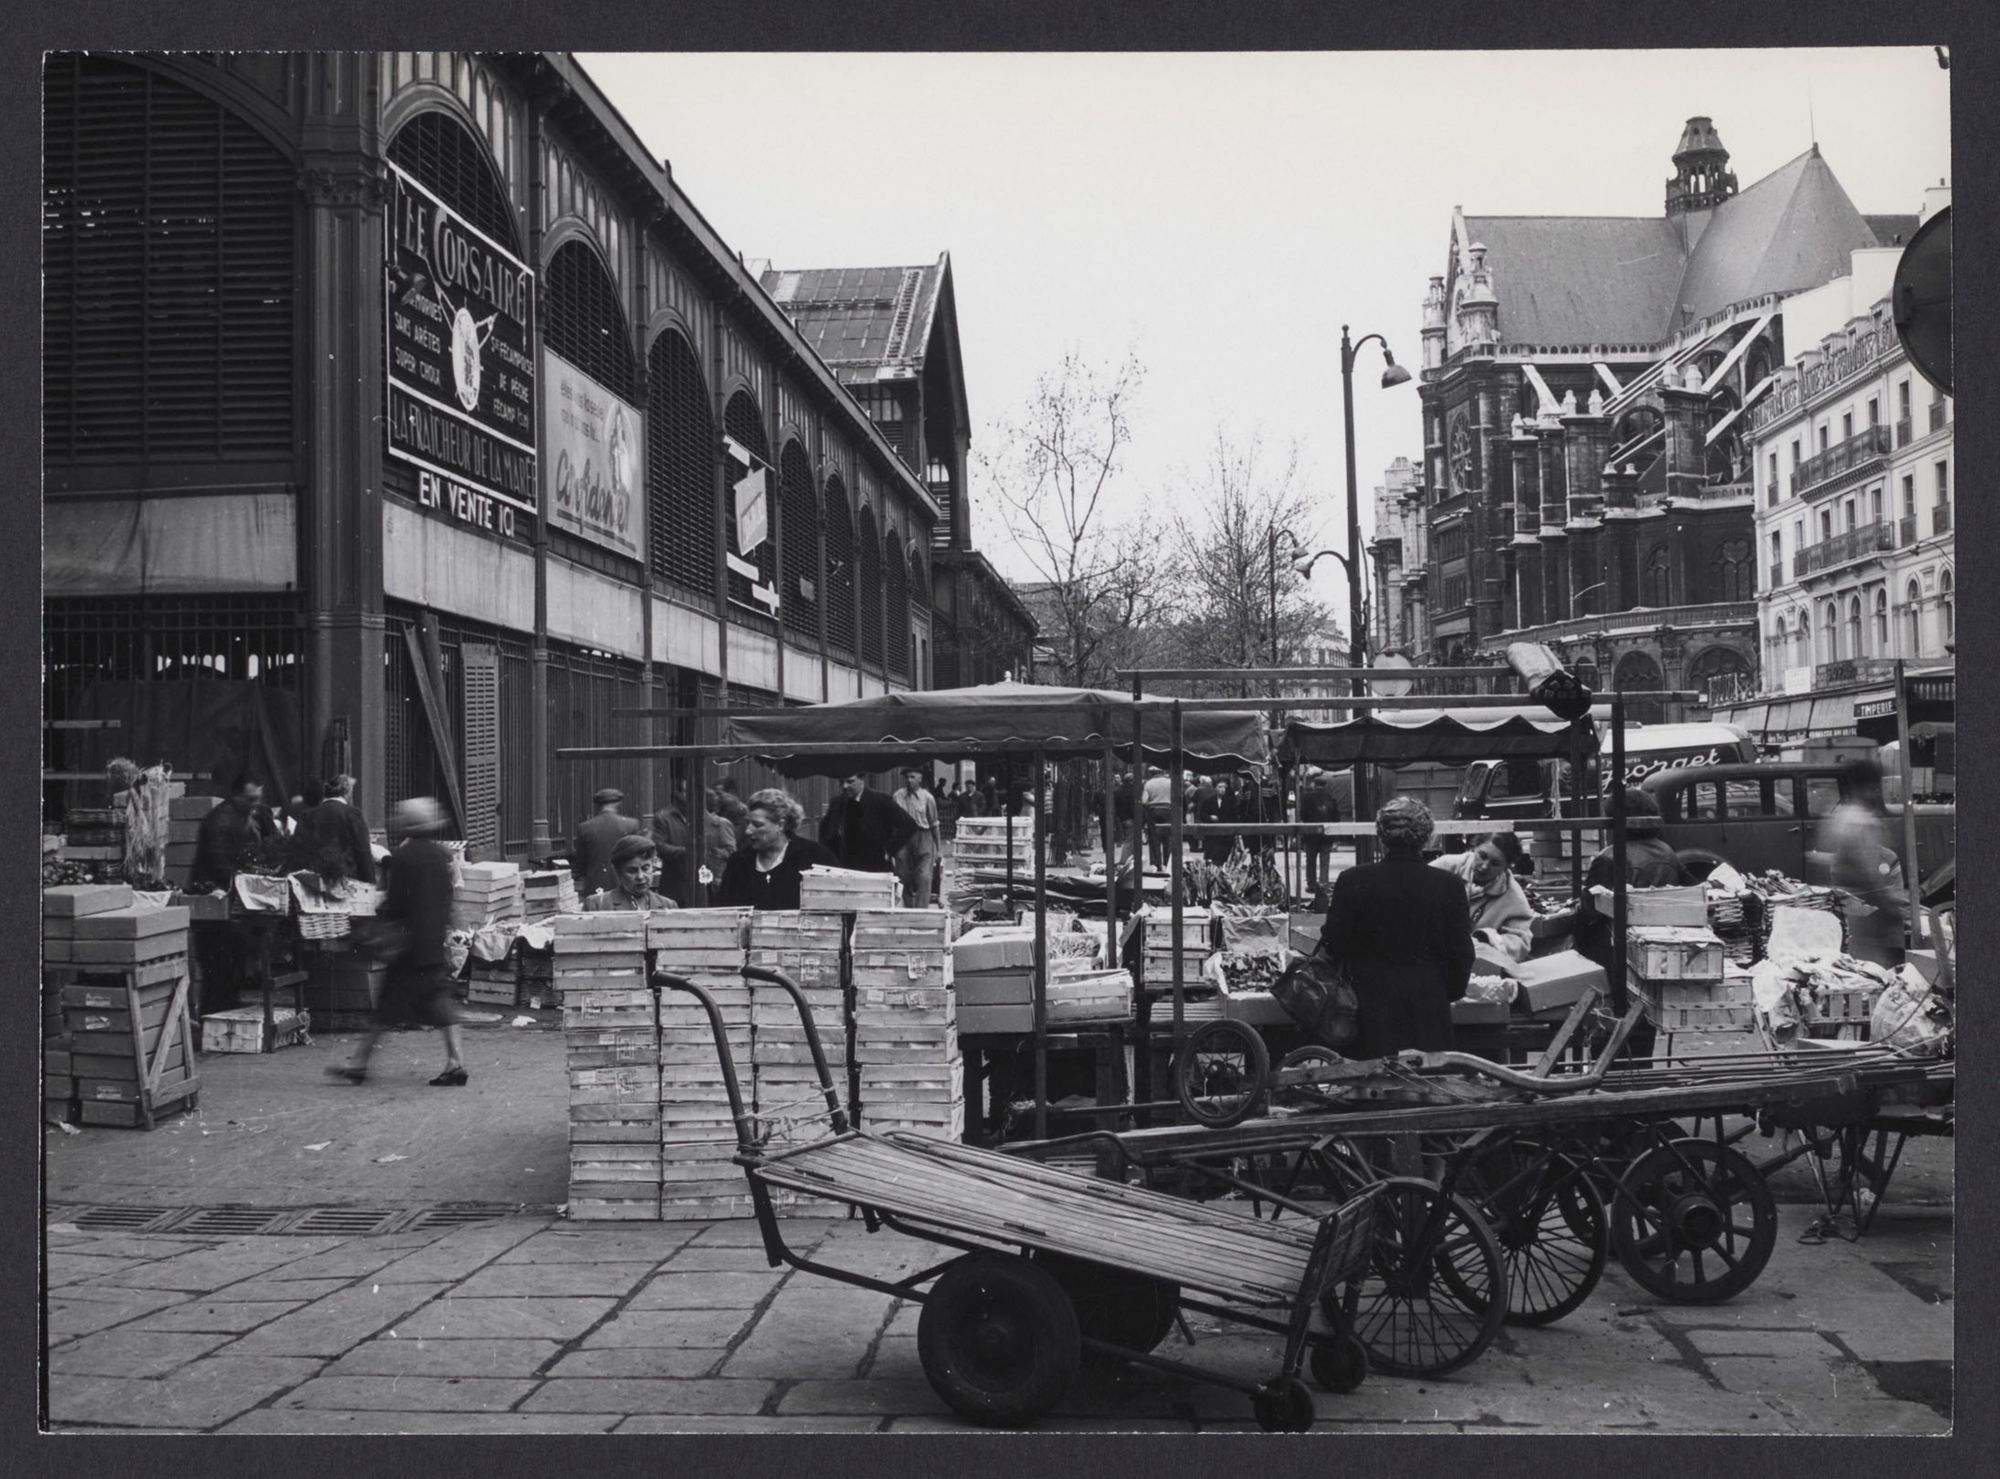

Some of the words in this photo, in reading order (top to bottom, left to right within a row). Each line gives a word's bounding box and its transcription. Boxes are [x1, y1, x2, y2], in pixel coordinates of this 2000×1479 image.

[403, 196, 428, 259] LE
[395, 346, 416, 375] SUPER
[393, 394, 408, 443] LA
[474, 434, 487, 478] DE
[489, 441, 502, 485] LA
[419, 470, 440, 509] EN
[448, 482, 493, 530] VENTE
[498, 503, 515, 538] ICI
